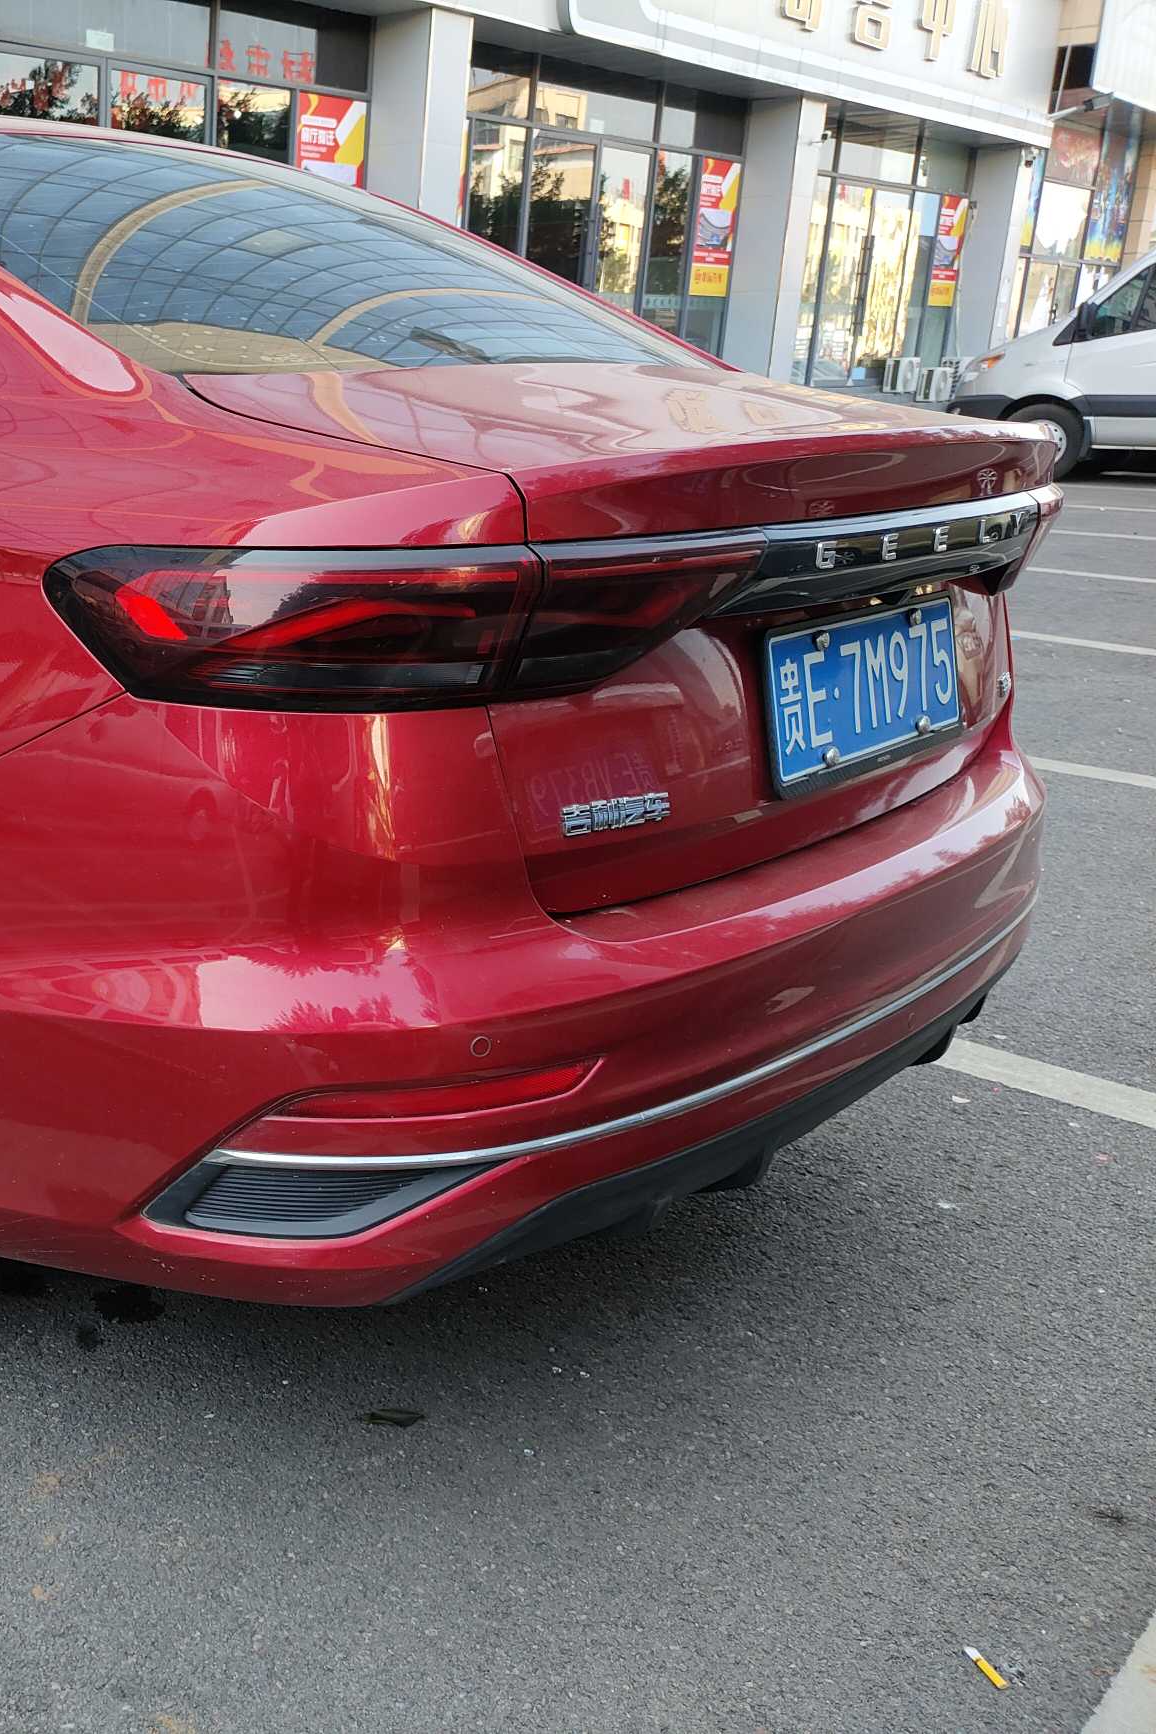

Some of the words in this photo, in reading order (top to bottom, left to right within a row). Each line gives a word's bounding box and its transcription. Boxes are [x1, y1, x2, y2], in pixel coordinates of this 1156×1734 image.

[815, 510, 1027, 570] GEELY
[560, 792, 671, 837] 吉利汽车
